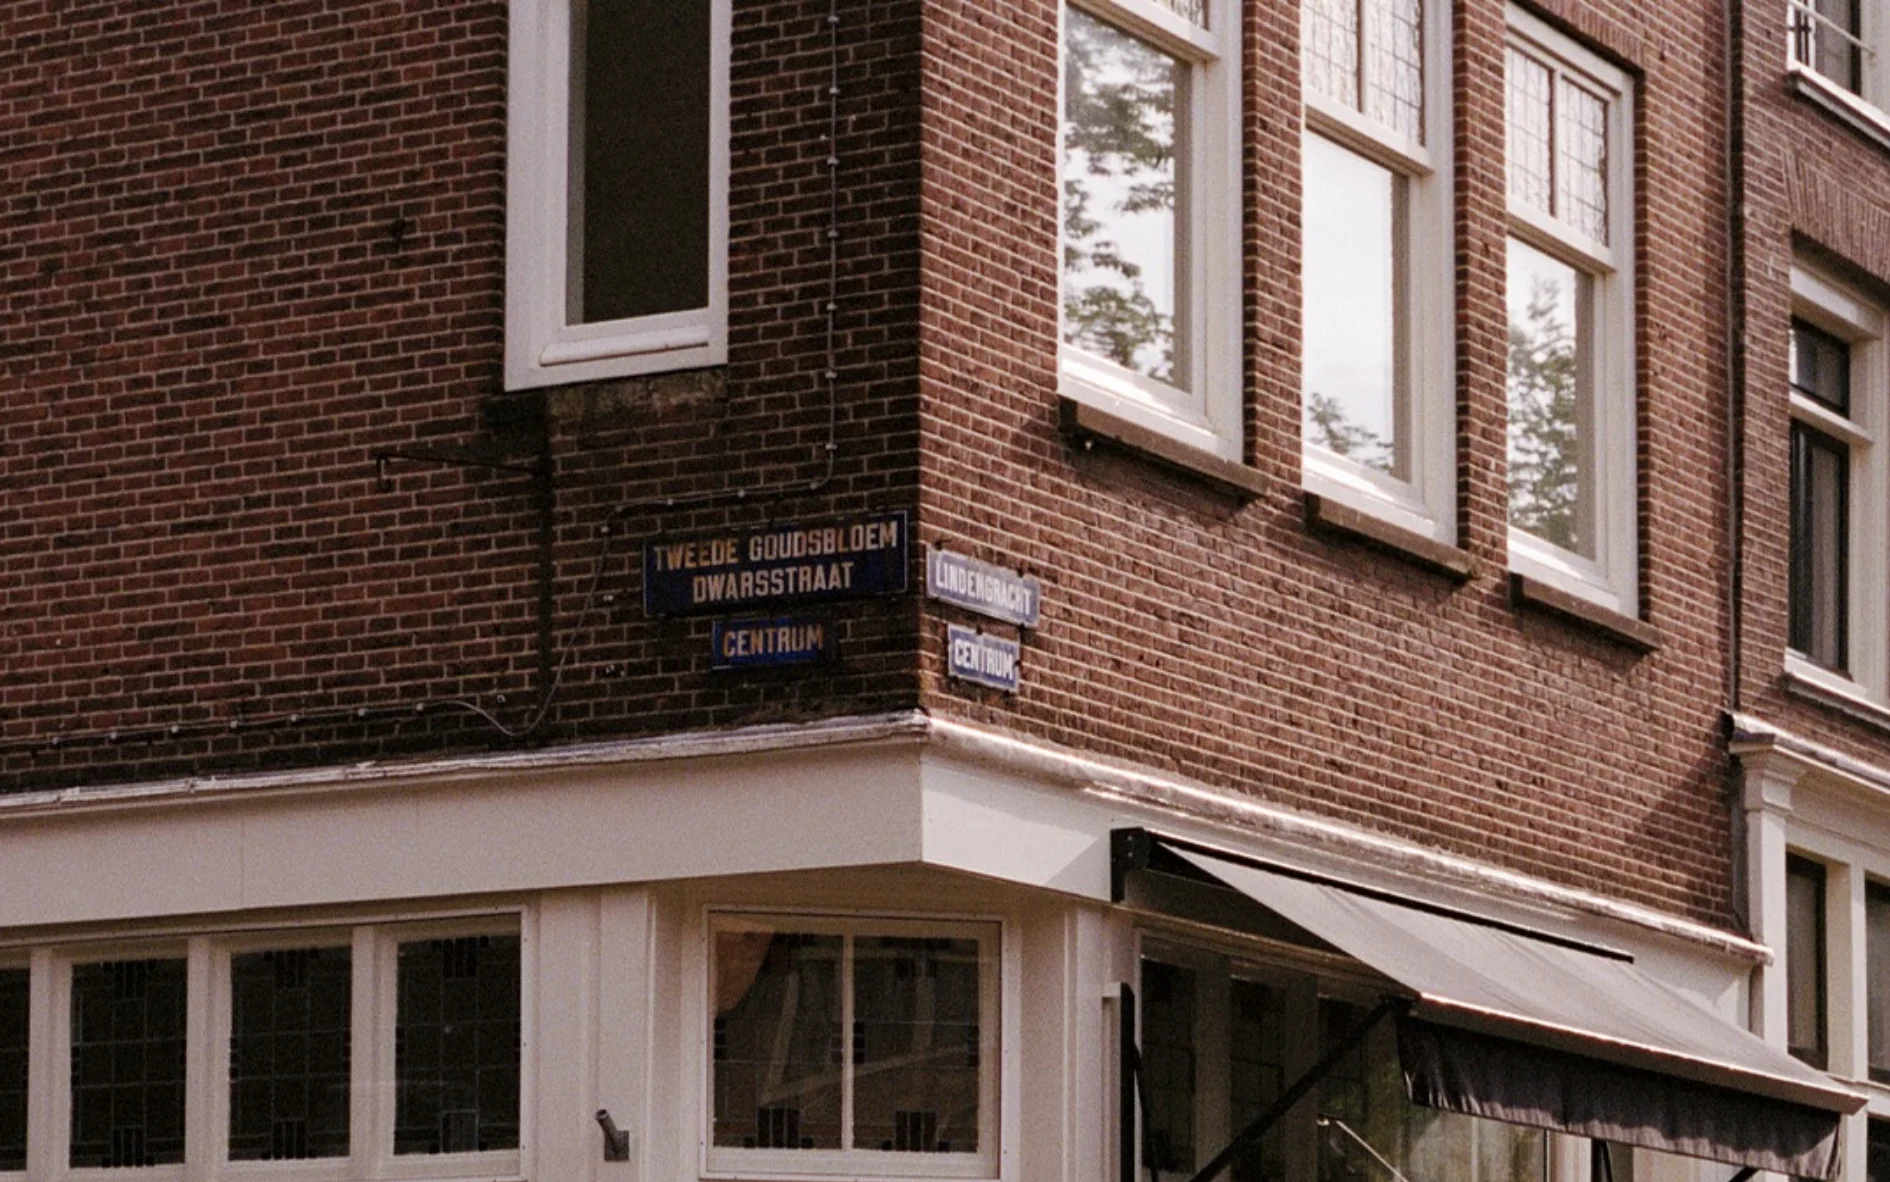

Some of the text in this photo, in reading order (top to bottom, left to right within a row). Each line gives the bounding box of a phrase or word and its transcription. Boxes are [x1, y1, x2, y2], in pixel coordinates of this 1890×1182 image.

[653, 520, 898, 572] TWEEDE GOUDSBLOEM
[692, 561, 854, 604] DWARSSTRAAT
[935, 559, 1032, 616] LINDENGRACHT
[723, 624, 825, 658] CENTRUM
[954, 637, 1014, 681] CENTRUM
